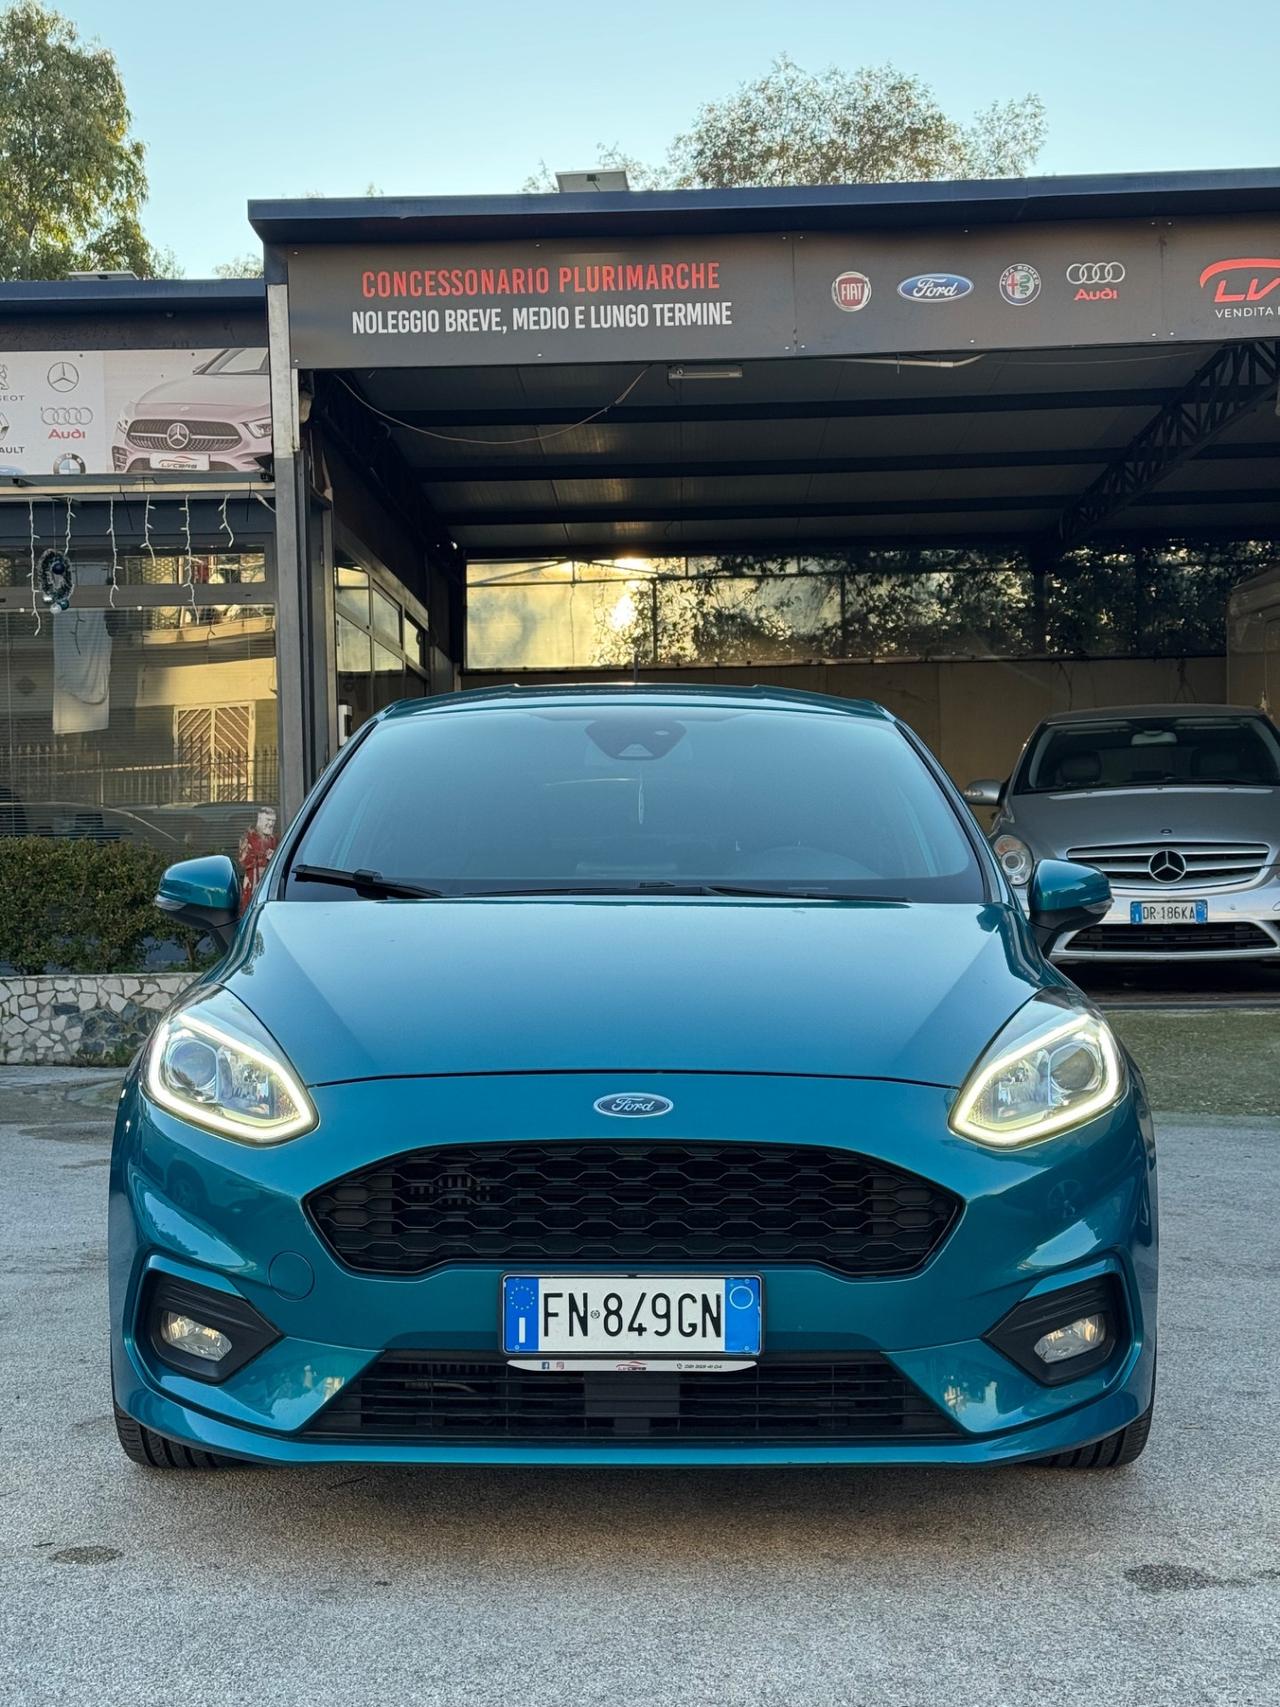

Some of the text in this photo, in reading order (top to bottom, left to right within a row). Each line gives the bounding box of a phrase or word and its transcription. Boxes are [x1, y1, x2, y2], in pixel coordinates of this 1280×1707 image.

[362, 262, 720, 298] CONCESSONARIO PLURIMARCHE
[912, 277, 958, 297] Ford
[841, 283, 863, 301] FIAT
[1074, 287, 1118, 301] Audi
[352, 301, 733, 334] NOLEGGIO BREVE, MEDIO E LUNGO TERMINE
[1215, 306, 1274, 319] VENDITA
[0, 394, 25, 402] EOT
[48, 428, 86, 440] Audi
[611, 1096, 656, 1112] Ford
